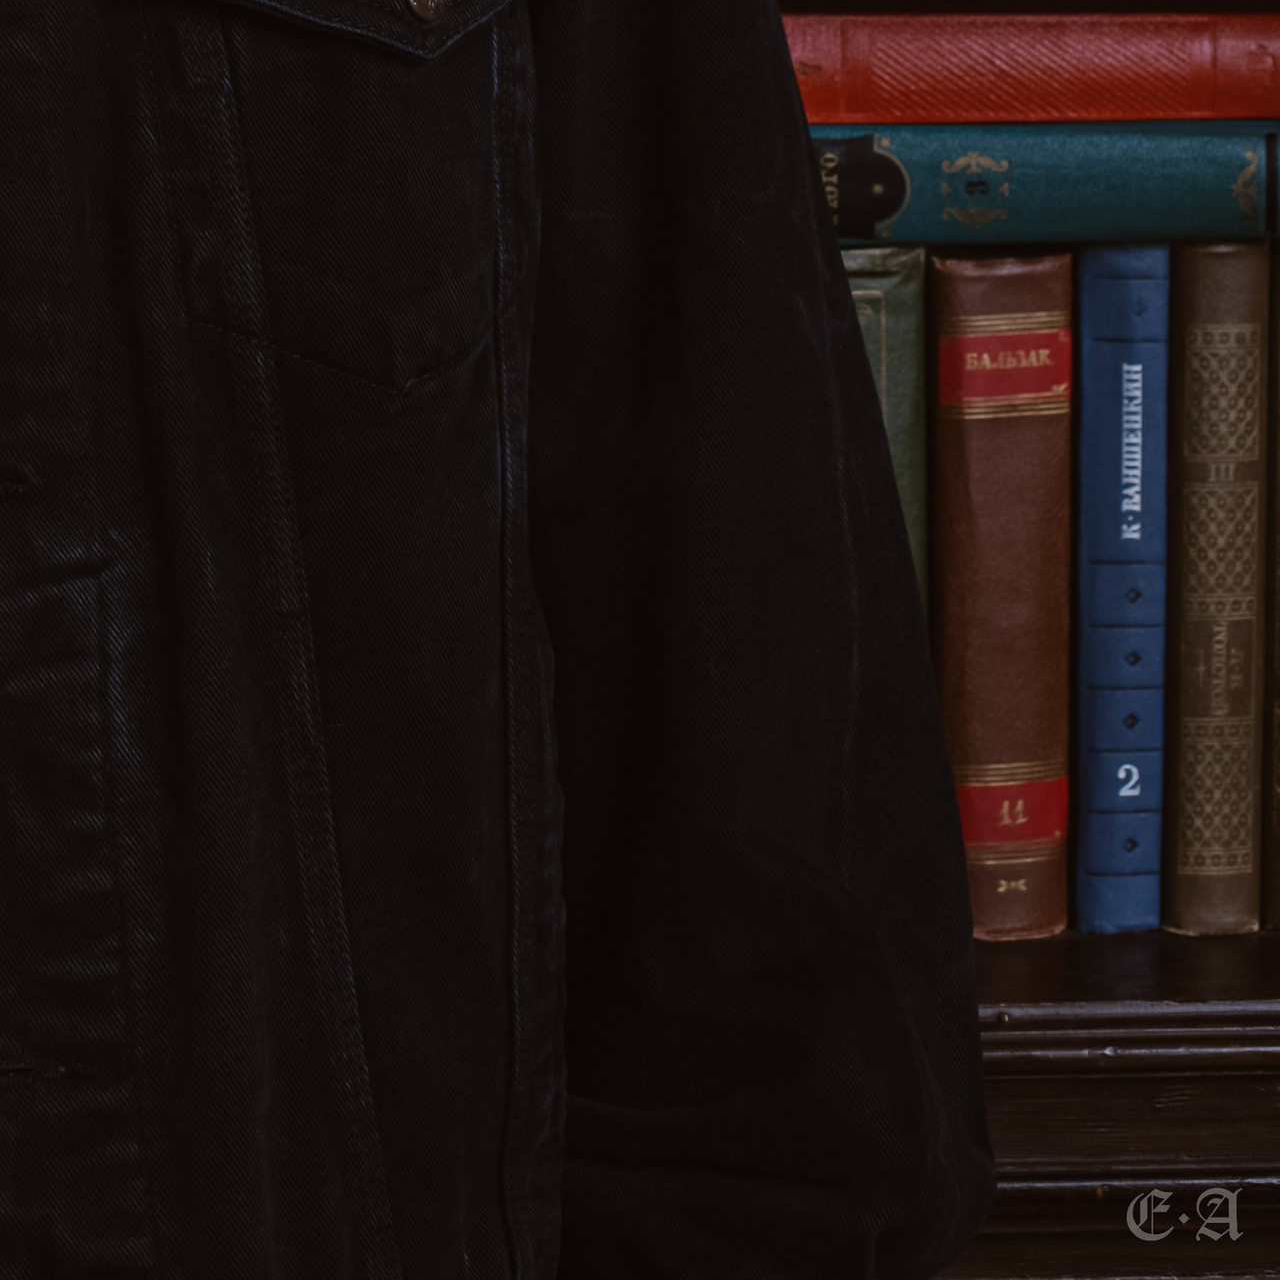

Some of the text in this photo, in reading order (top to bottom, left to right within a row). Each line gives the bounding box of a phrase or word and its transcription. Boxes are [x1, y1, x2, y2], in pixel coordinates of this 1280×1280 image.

[963, 180, 989, 196] 3
[963, 347, 1055, 373] БАЛЬЗАК
[1116, 763, 1141, 797] 2
[998, 799, 1030, 827] 11
